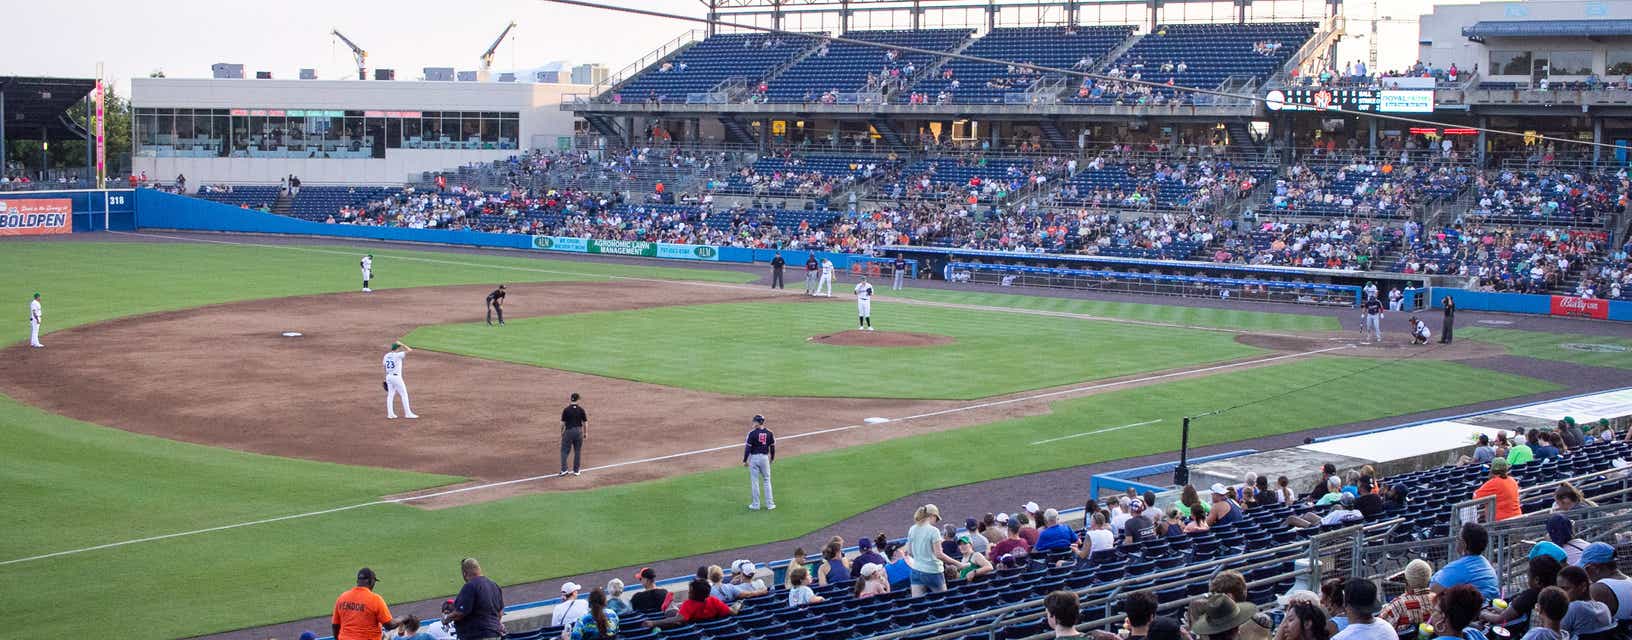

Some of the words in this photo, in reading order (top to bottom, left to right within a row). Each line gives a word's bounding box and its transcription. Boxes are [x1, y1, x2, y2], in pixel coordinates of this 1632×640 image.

[110, 196, 124, 205] 318
[0, 213, 66, 228] BOLDPEN
[594, 240, 631, 249] AGRONOMIC
[632, 241, 650, 250] LAWN
[600, 247, 643, 255] MANAGEMENT
[698, 247, 711, 256] ALM
[386, 360, 395, 369] 23
